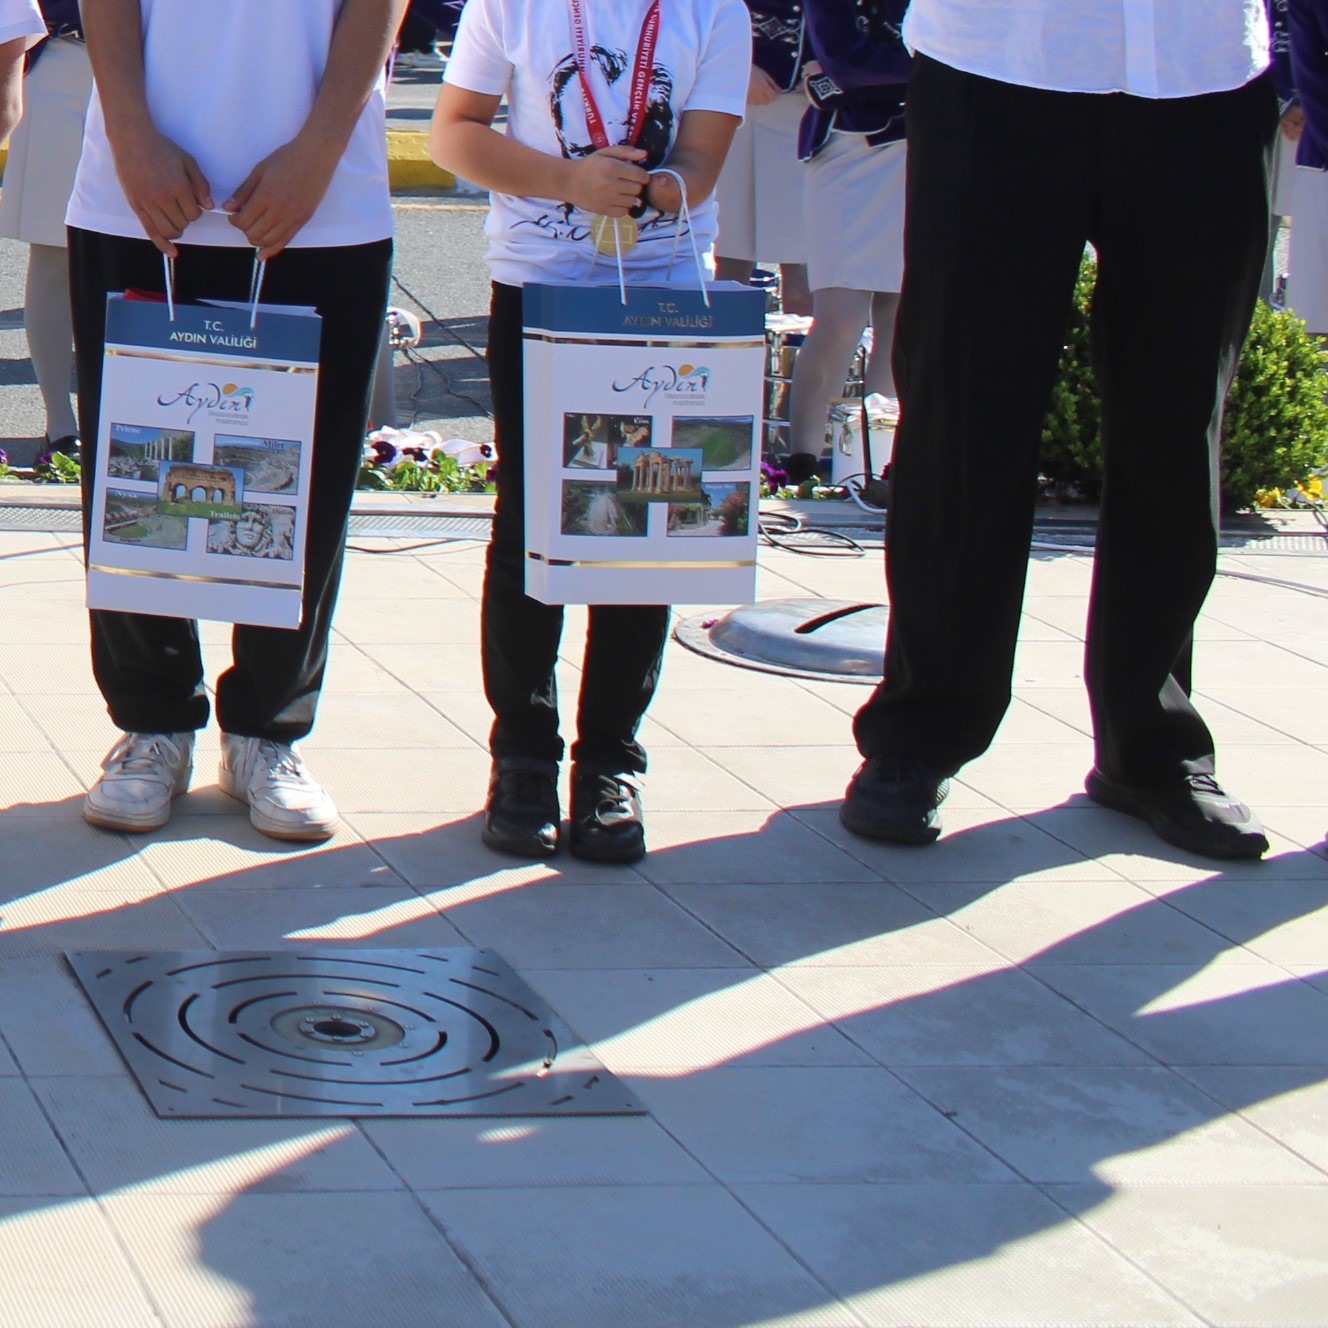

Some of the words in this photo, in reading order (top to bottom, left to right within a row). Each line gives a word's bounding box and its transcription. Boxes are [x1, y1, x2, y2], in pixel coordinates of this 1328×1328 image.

[632, 70, 646, 111] GENÇLİK
[629, 112, 639, 124] VE
[204, 320, 225, 333] T.C.
[169, 332, 207, 344] AYDIN
[210, 334, 257, 349] VALİLİĞİ
[115, 425, 141, 434] Priene
[263, 440, 285, 449] Milet
[210, 510, 241, 520] Tralleis
